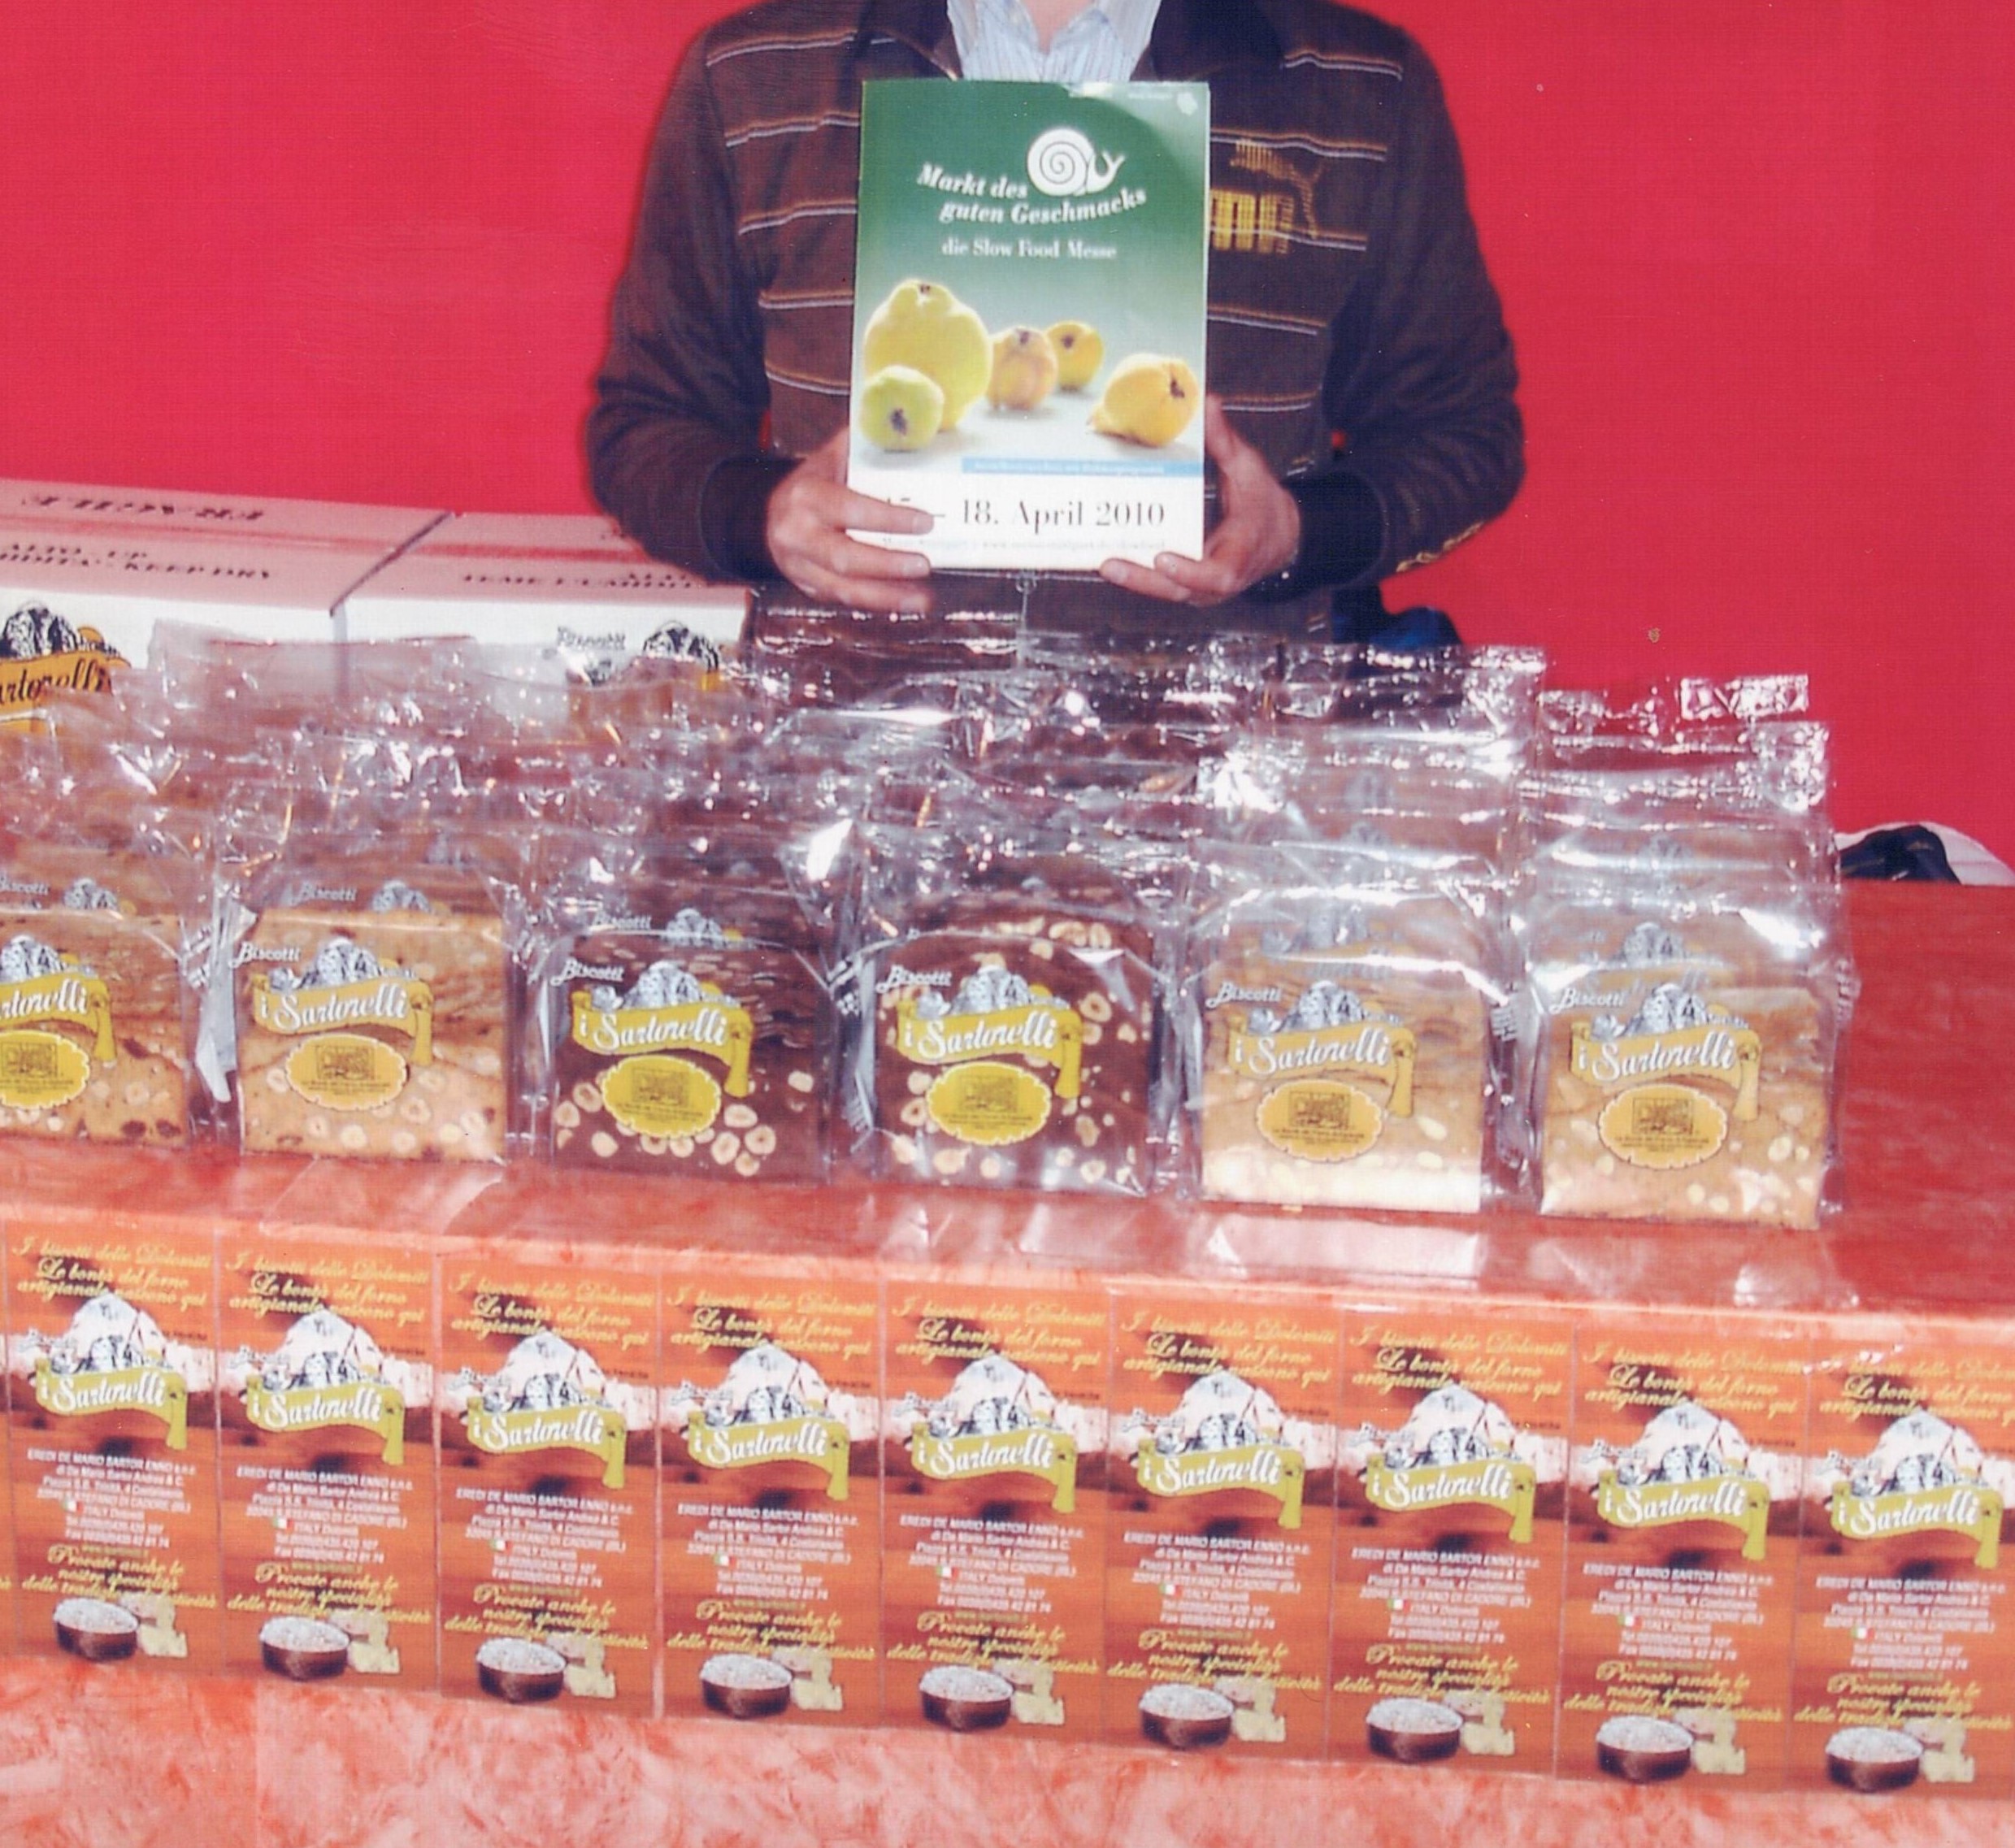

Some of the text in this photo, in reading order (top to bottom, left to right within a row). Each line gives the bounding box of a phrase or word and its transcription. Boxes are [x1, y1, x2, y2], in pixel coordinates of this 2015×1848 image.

[917, 163, 1028, 199] Markt des
[938, 187, 1147, 224] guten Geschmacks
[941, 238, 1118, 260] die Slow Food Messe
[962, 499, 1165, 535] 18. April 2010
[228, 942, 302, 969] Biscotti
[551, 957, 624, 986] Biscotti
[875, 965, 953, 994] Biscotti
[260, 983, 407, 1031] i Sartorelli
[1205, 982, 1283, 1009] Biscotti
[1548, 987, 1625, 1014] Biscotti
[580, 1008, 727, 1052] i Sartorelli
[905, 1011, 1057, 1060] i Sartorelli
[1235, 1027, 1391, 1075] i Sartorelli
[1579, 1030, 1736, 1082] i Sartorelli
[919, 1448, 926, 1464] i
[1144, 1464, 1151, 1480] i
[1374, 1480, 1380, 1495] i
[1605, 1496, 1612, 1512] i
